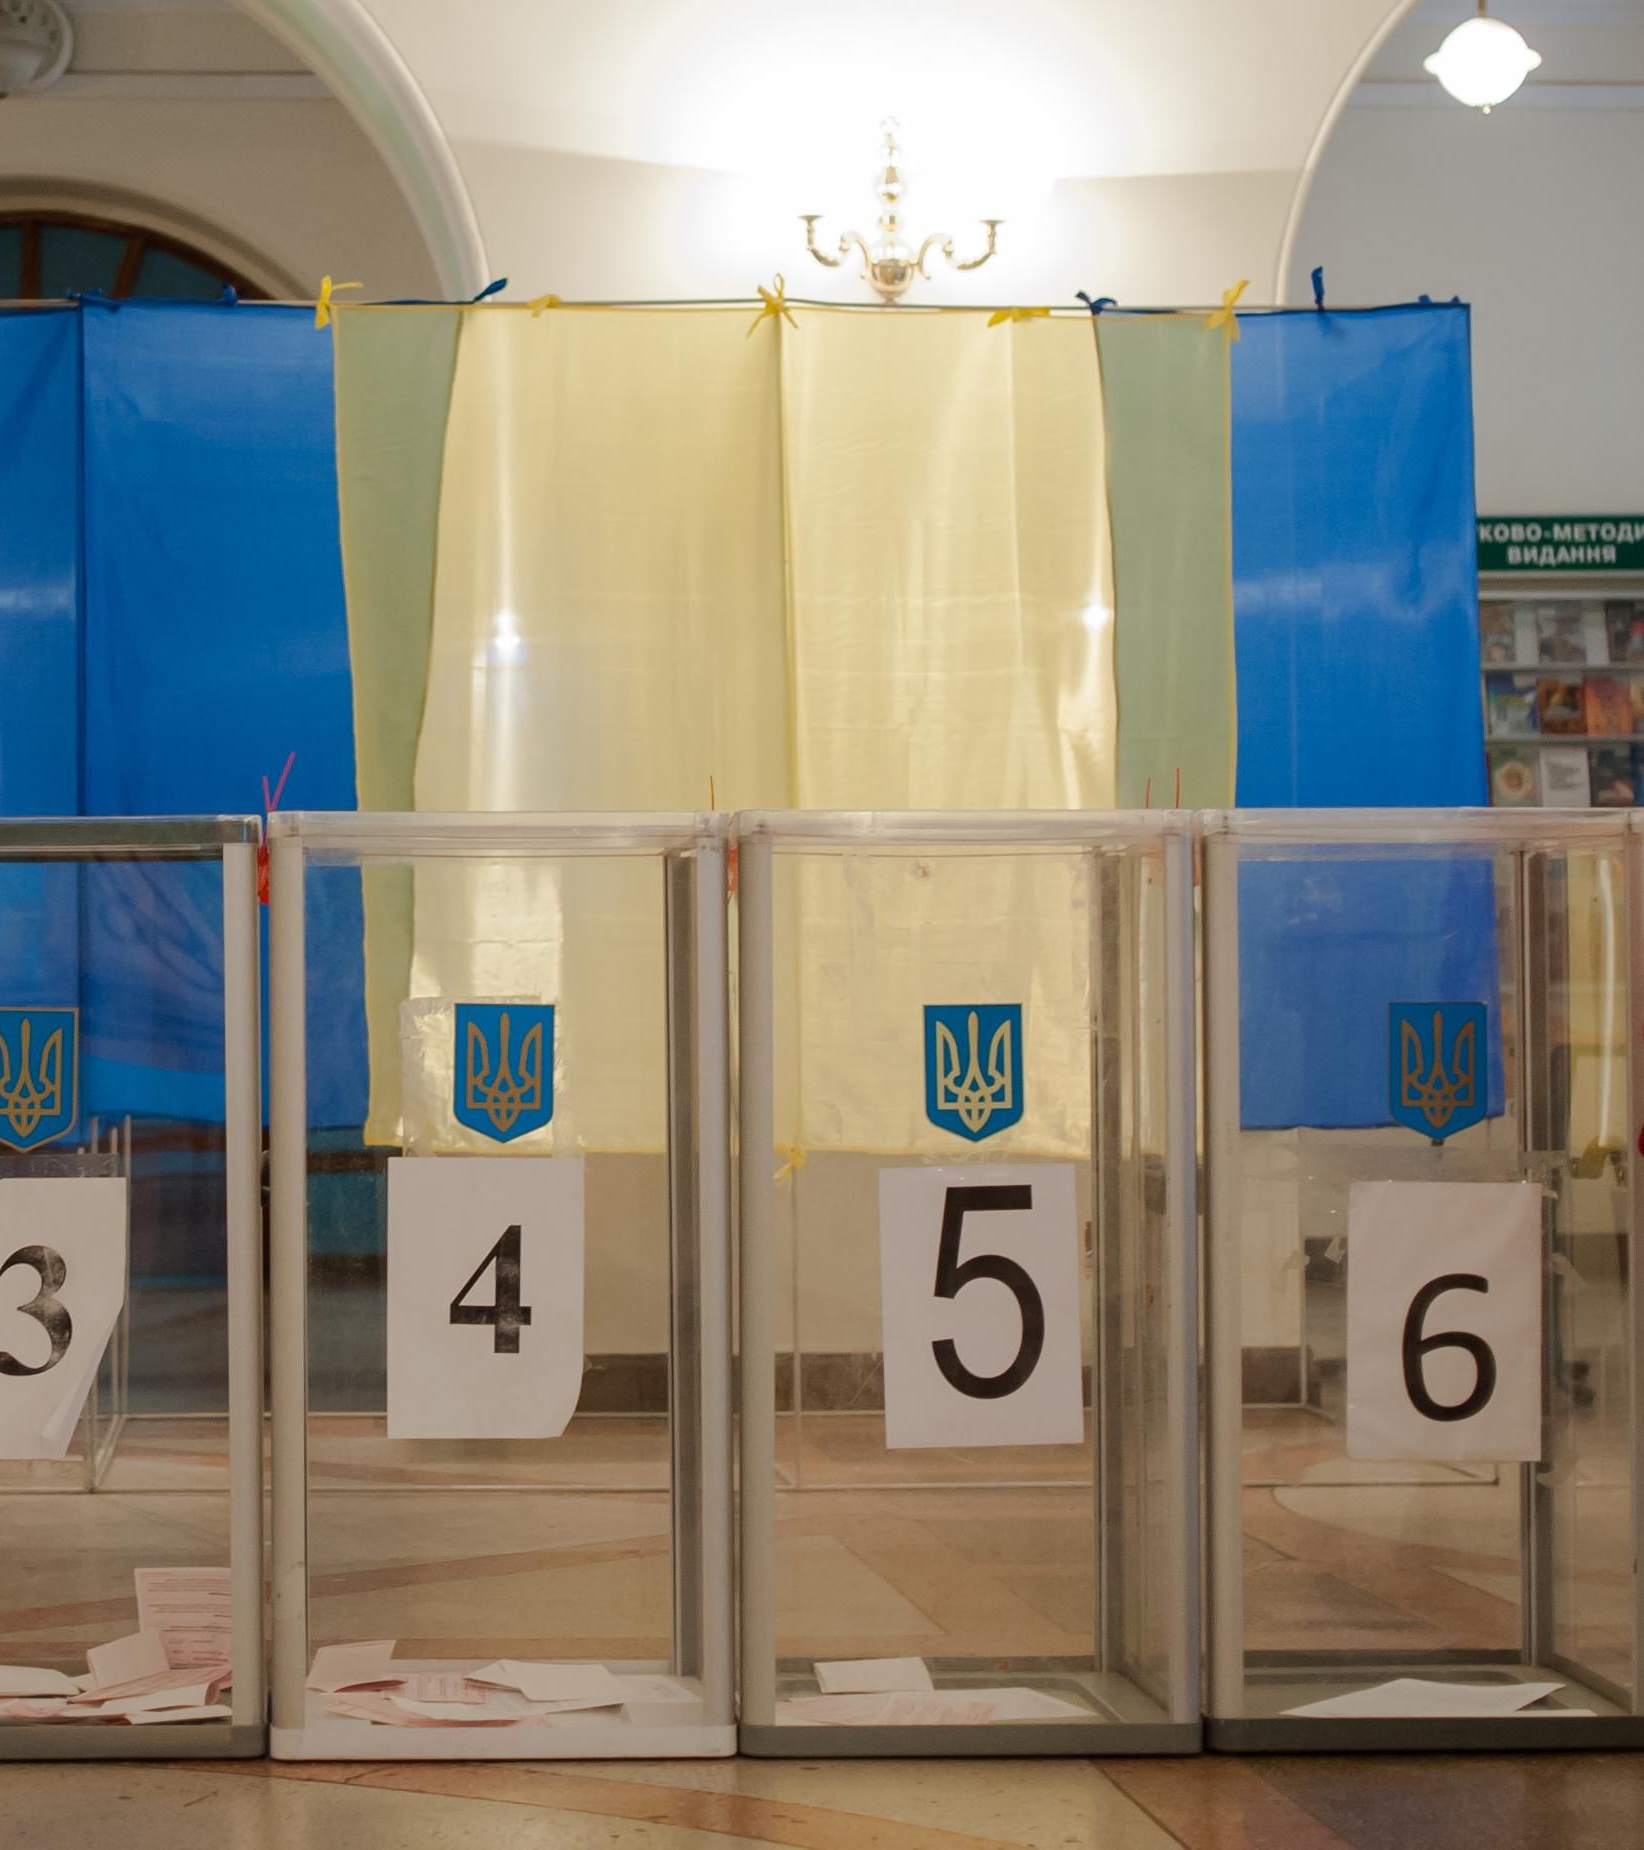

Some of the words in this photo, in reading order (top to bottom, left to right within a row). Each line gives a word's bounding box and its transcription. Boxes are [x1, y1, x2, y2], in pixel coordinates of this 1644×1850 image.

[1507, 545, 1617, 566] ВИДАННЯ
[449, 1224, 532, 1354] 4
[931, 1184, 1045, 1400] 5
[1401, 1272, 1497, 1423] 6
